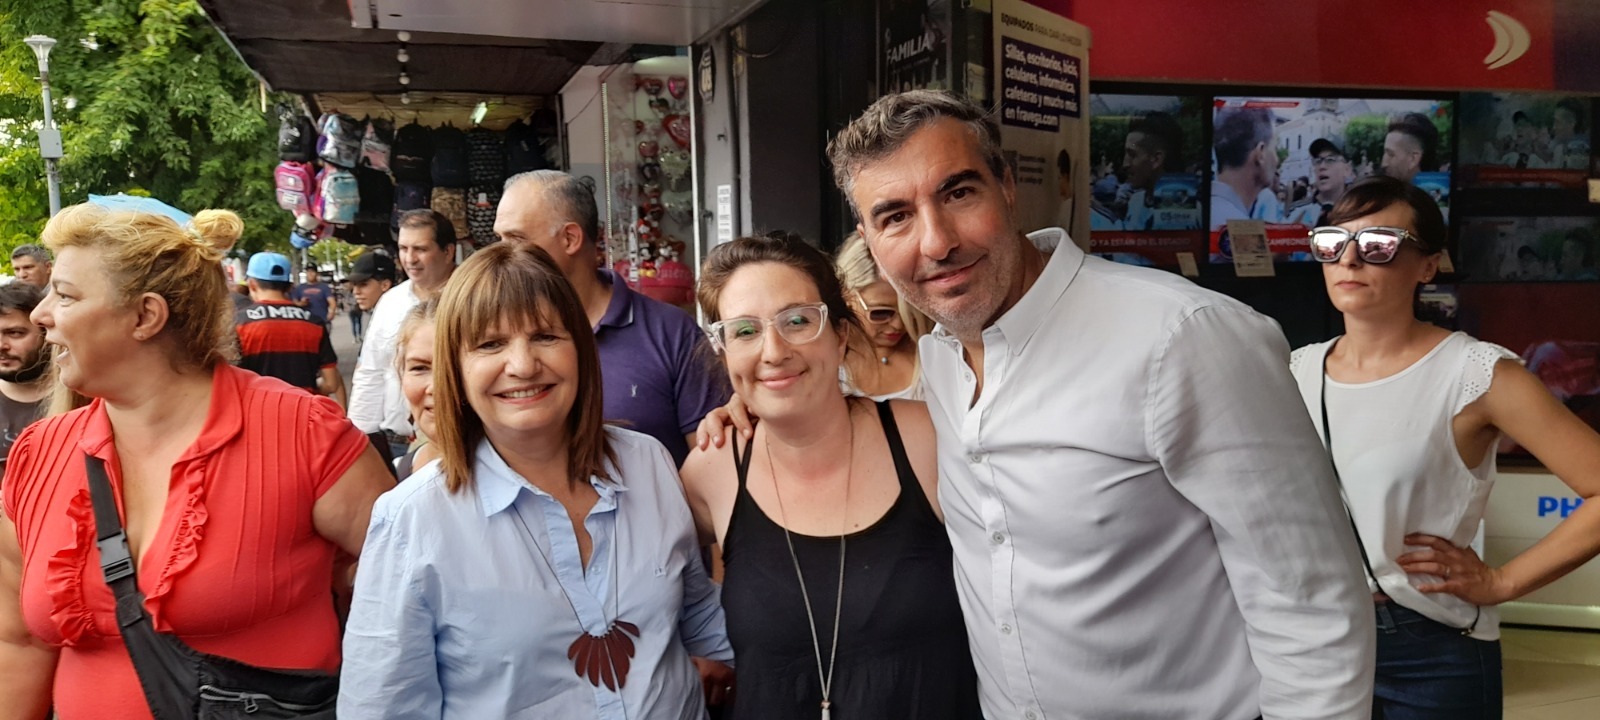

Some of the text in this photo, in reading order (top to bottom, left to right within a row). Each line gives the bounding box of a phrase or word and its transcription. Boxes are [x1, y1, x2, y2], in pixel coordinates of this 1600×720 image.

[1001, 12, 1034, 31] EQUIPADOS
[886, 32, 932, 64] FAMILIA
[1005, 43, 1078, 78] Sillas, escritorios, bicis,
[1005, 65, 1075, 95] celulares, informática,
[1005, 86, 1078, 112] cafeteras y mucho más
[1005, 106, 1058, 127] en fravega.com
[1137, 238, 1147, 246] EN
[1148, 238, 1158, 246] EL
